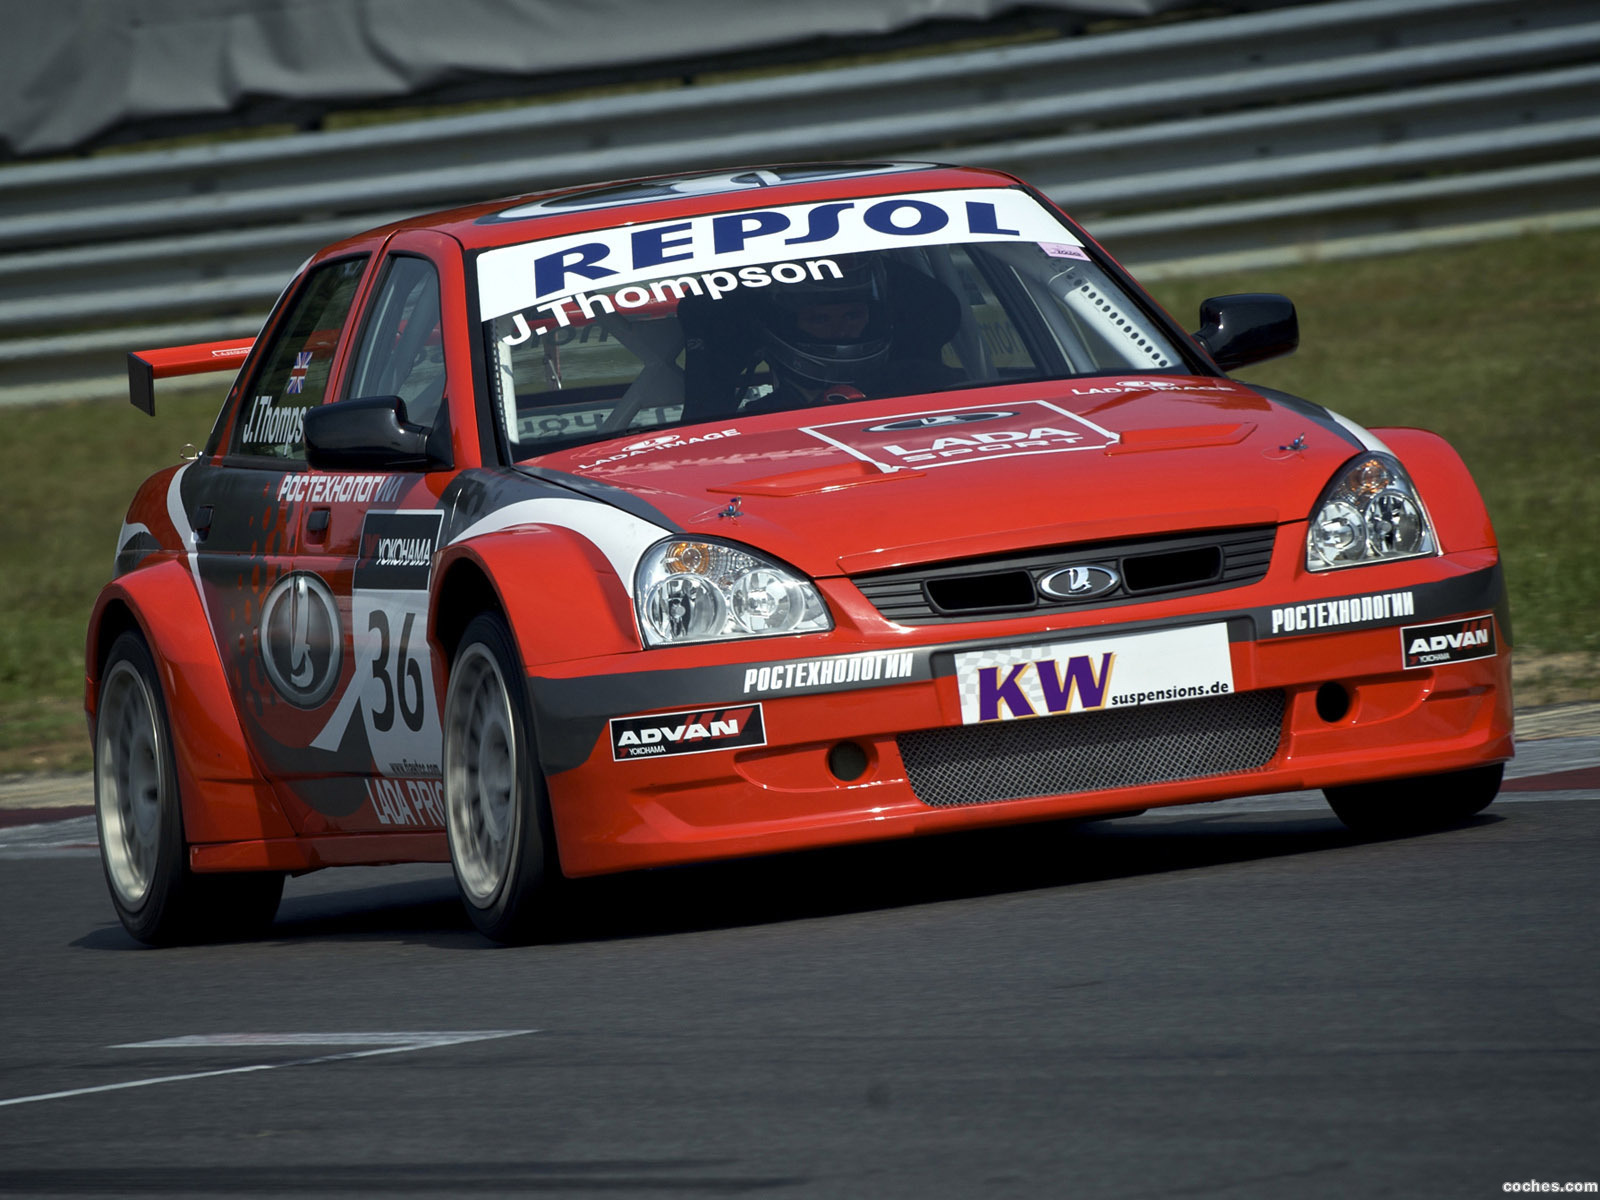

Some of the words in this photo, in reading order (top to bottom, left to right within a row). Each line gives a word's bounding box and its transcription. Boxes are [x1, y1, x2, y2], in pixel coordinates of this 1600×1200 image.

[535, 198, 1020, 300] REPSOL
[502, 258, 843, 346] J.Thompson
[1071, 385, 1237, 396] LADA-IMAGE
[242, 395, 314, 456] J.Thomps
[883, 427, 1080, 456] LADA
[578, 428, 741, 469] LADA-IMAGE
[902, 436, 1084, 463] SPORT
[376, 538, 432, 566] YOKOHAMA
[1271, 591, 1415, 634] РОСТЕХНОЛОГИИ
[1408, 628, 1489, 655] ADVAN
[368, 609, 425, 732] 36
[743, 652, 914, 694] РОСТЕХНОЛОГИИ
[977, 652, 1117, 723] KW
[1111, 680, 1230, 706] suspensions.de
[617, 719, 739, 747] ADVAN
[628, 744, 667, 757] YOKOHAMA
[364, 778, 418, 826] LADA
